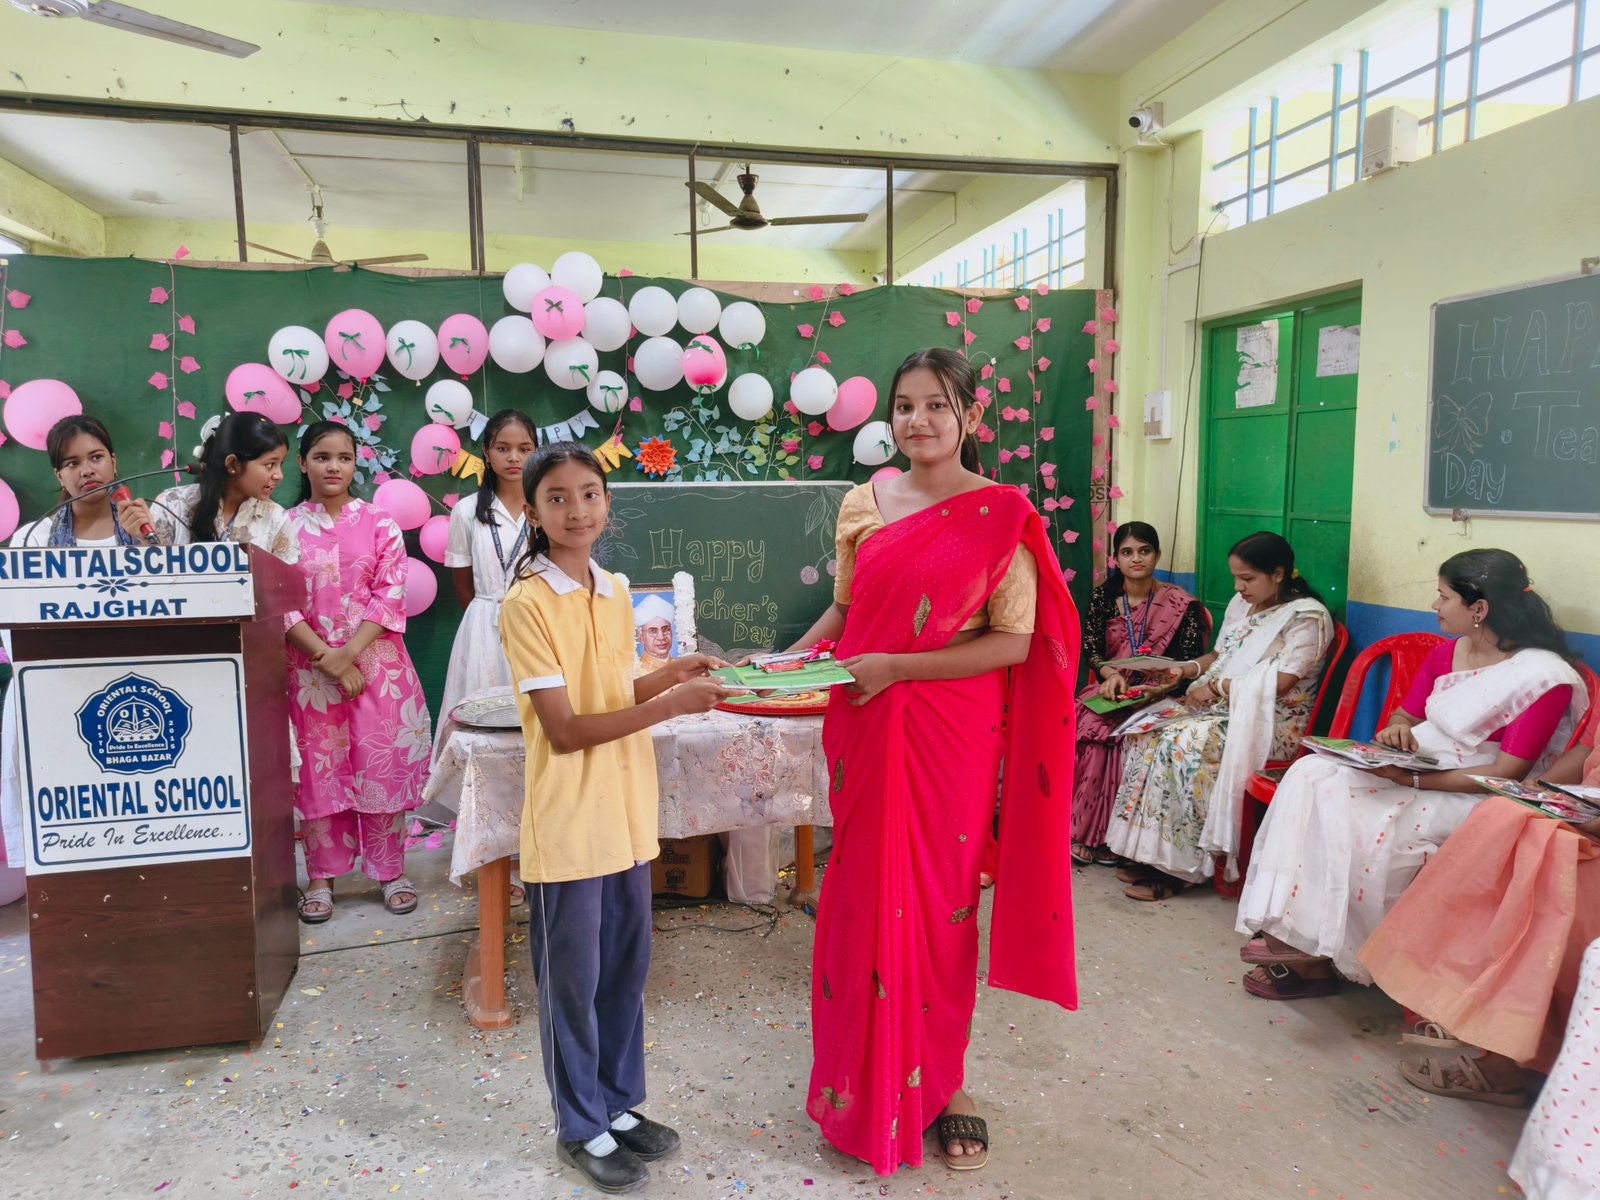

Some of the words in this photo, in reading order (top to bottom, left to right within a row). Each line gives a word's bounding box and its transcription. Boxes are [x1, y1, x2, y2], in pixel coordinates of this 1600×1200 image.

[1451, 302, 1600, 384] HAP
[1511, 390, 1599, 464] Tea
[1445, 452, 1507, 504] Day
[649, 528, 766, 583] Happy
[39, 598, 188, 620] RAJGHAT
[694, 587, 779, 622] cher's
[733, 621, 777, 647] Day
[97, 685, 138, 718] ORIENTAL
[140, 685, 173, 715] SCHOOL
[120, 709, 130, 718] O
[142, 708, 151, 717] S
[106, 755, 139, 764] BHAGA
[141, 753, 172, 762] BAZAR
[38, 781, 149, 822] ORIENTAL
[154, 775, 241, 813] SCHOOL
[42, 832, 95, 852] Pride
[103, 827, 125, 846] In
